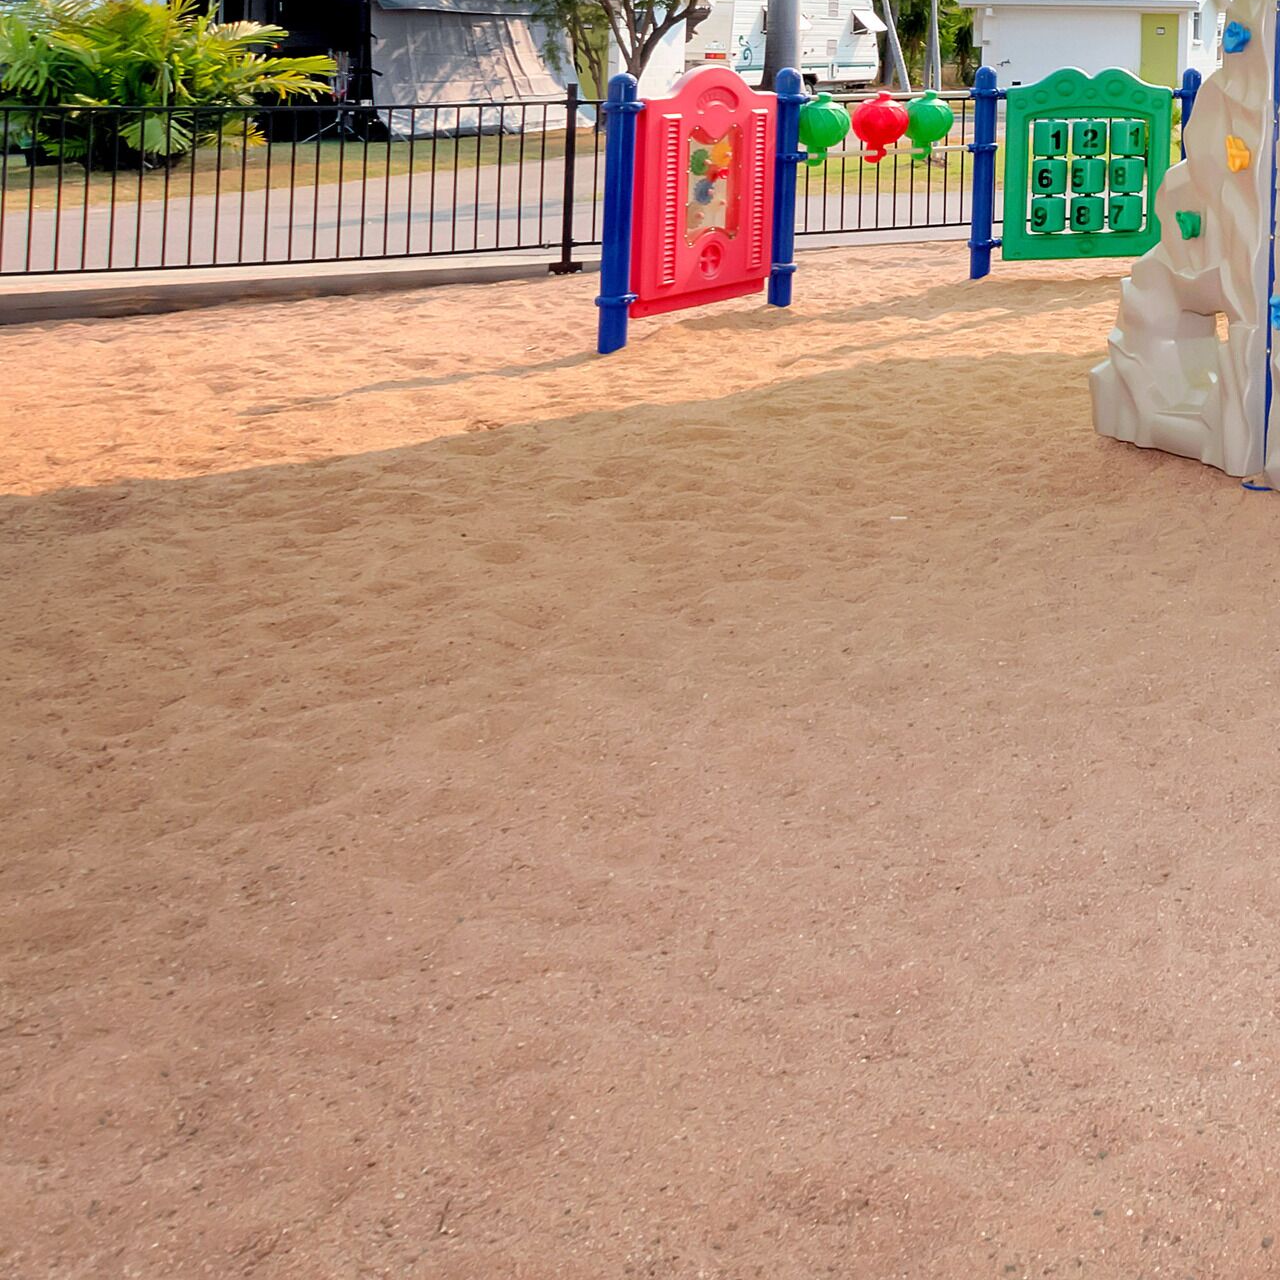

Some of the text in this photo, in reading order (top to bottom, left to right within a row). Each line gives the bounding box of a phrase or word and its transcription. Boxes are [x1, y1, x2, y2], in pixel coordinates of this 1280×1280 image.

[1051, 127, 1140, 149] 1 2 1
[1038, 167, 1126, 188] 6 5 8
[1034, 205, 1124, 227] 9 8 7
